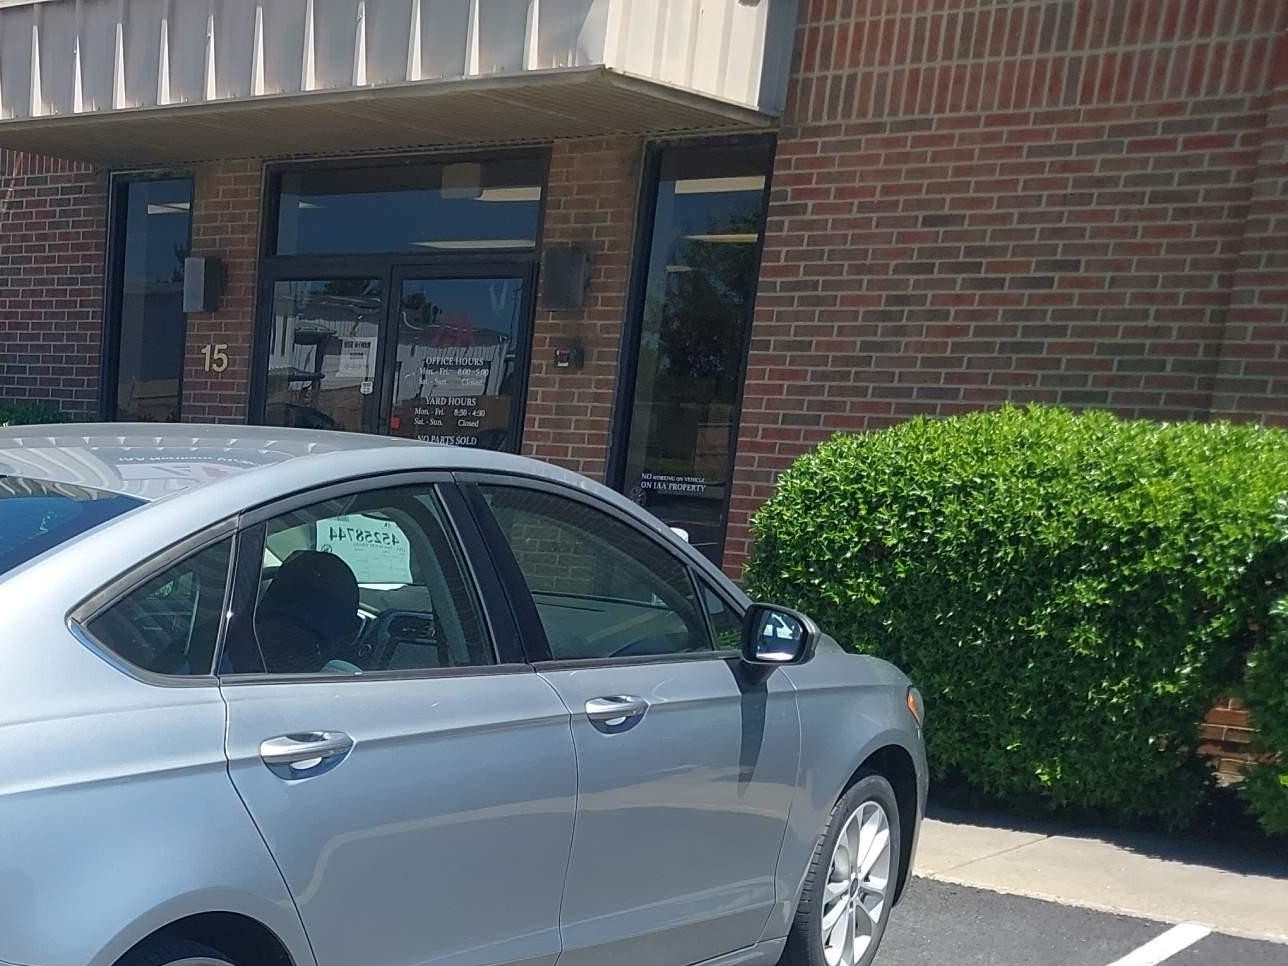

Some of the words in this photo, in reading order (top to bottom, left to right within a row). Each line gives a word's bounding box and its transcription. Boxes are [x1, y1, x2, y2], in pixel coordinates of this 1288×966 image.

[201, 344, 228, 372] 15
[426, 356, 453, 366] OFFICE
[455, 357, 484, 366] HOURS
[425, 396, 447, 405] YARD
[448, 397, 477, 407] HOURS
[457, 419, 479, 427] Closed
[431, 435, 455, 446] PARTS
[455, 436, 478, 445] SOLD
[640, 481, 652, 489] ON
[653, 481, 667, 490] IAA
[668, 482, 706, 492] PROPERTY
